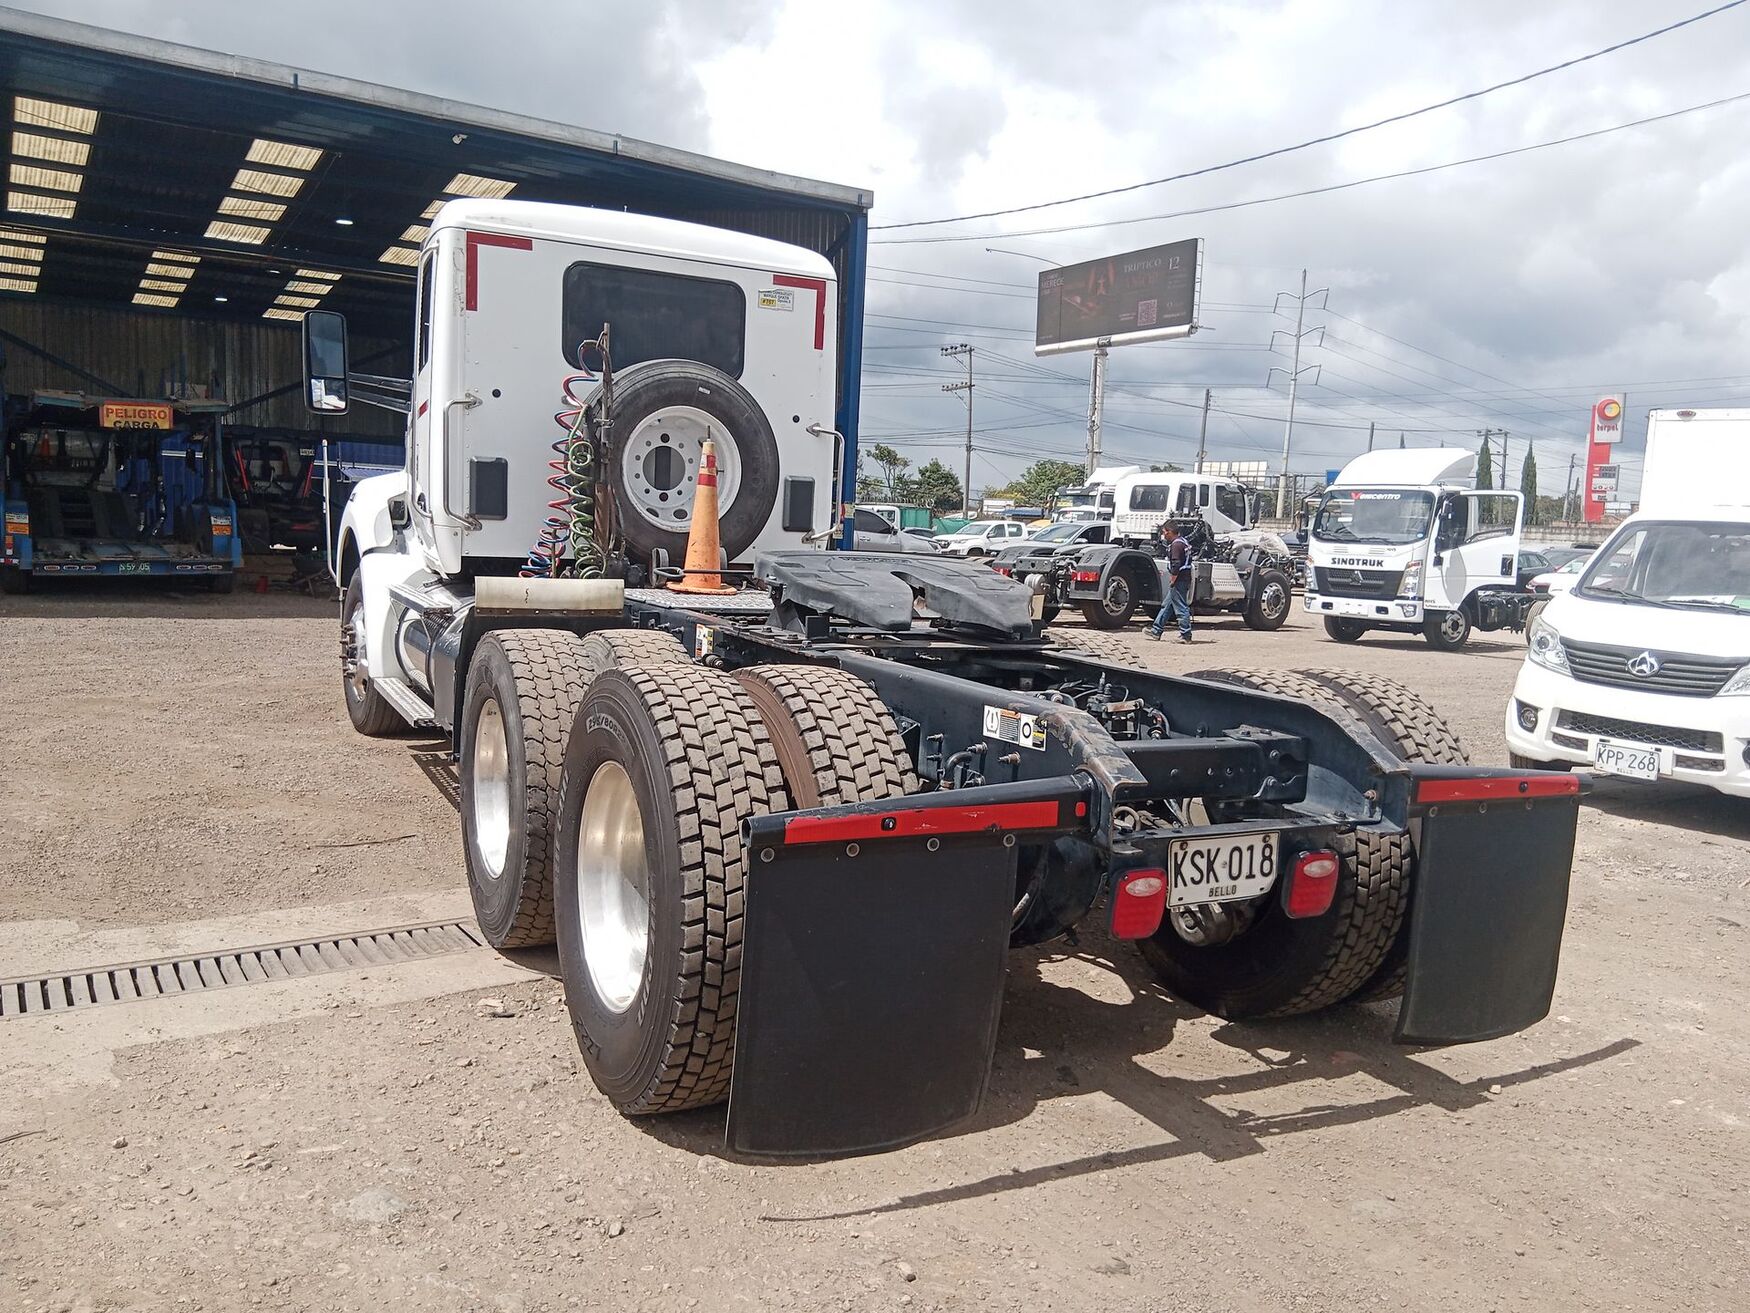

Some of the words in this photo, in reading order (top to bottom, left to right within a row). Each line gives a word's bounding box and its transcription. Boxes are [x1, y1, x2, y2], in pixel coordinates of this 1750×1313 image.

[1169, 256, 1180, 270] 12
[106, 407, 167, 420] PELIGRO
[113, 420, 160, 429] CARGA
[1331, 557, 1384, 567] SINOTRUK
[1597, 748, 1625, 765] KPP
[1628, 753, 1656, 772] 268
[1173, 848, 1220, 888] KSK
[1228, 843, 1274, 881] 018
[1208, 884, 1237, 898] BELLO
